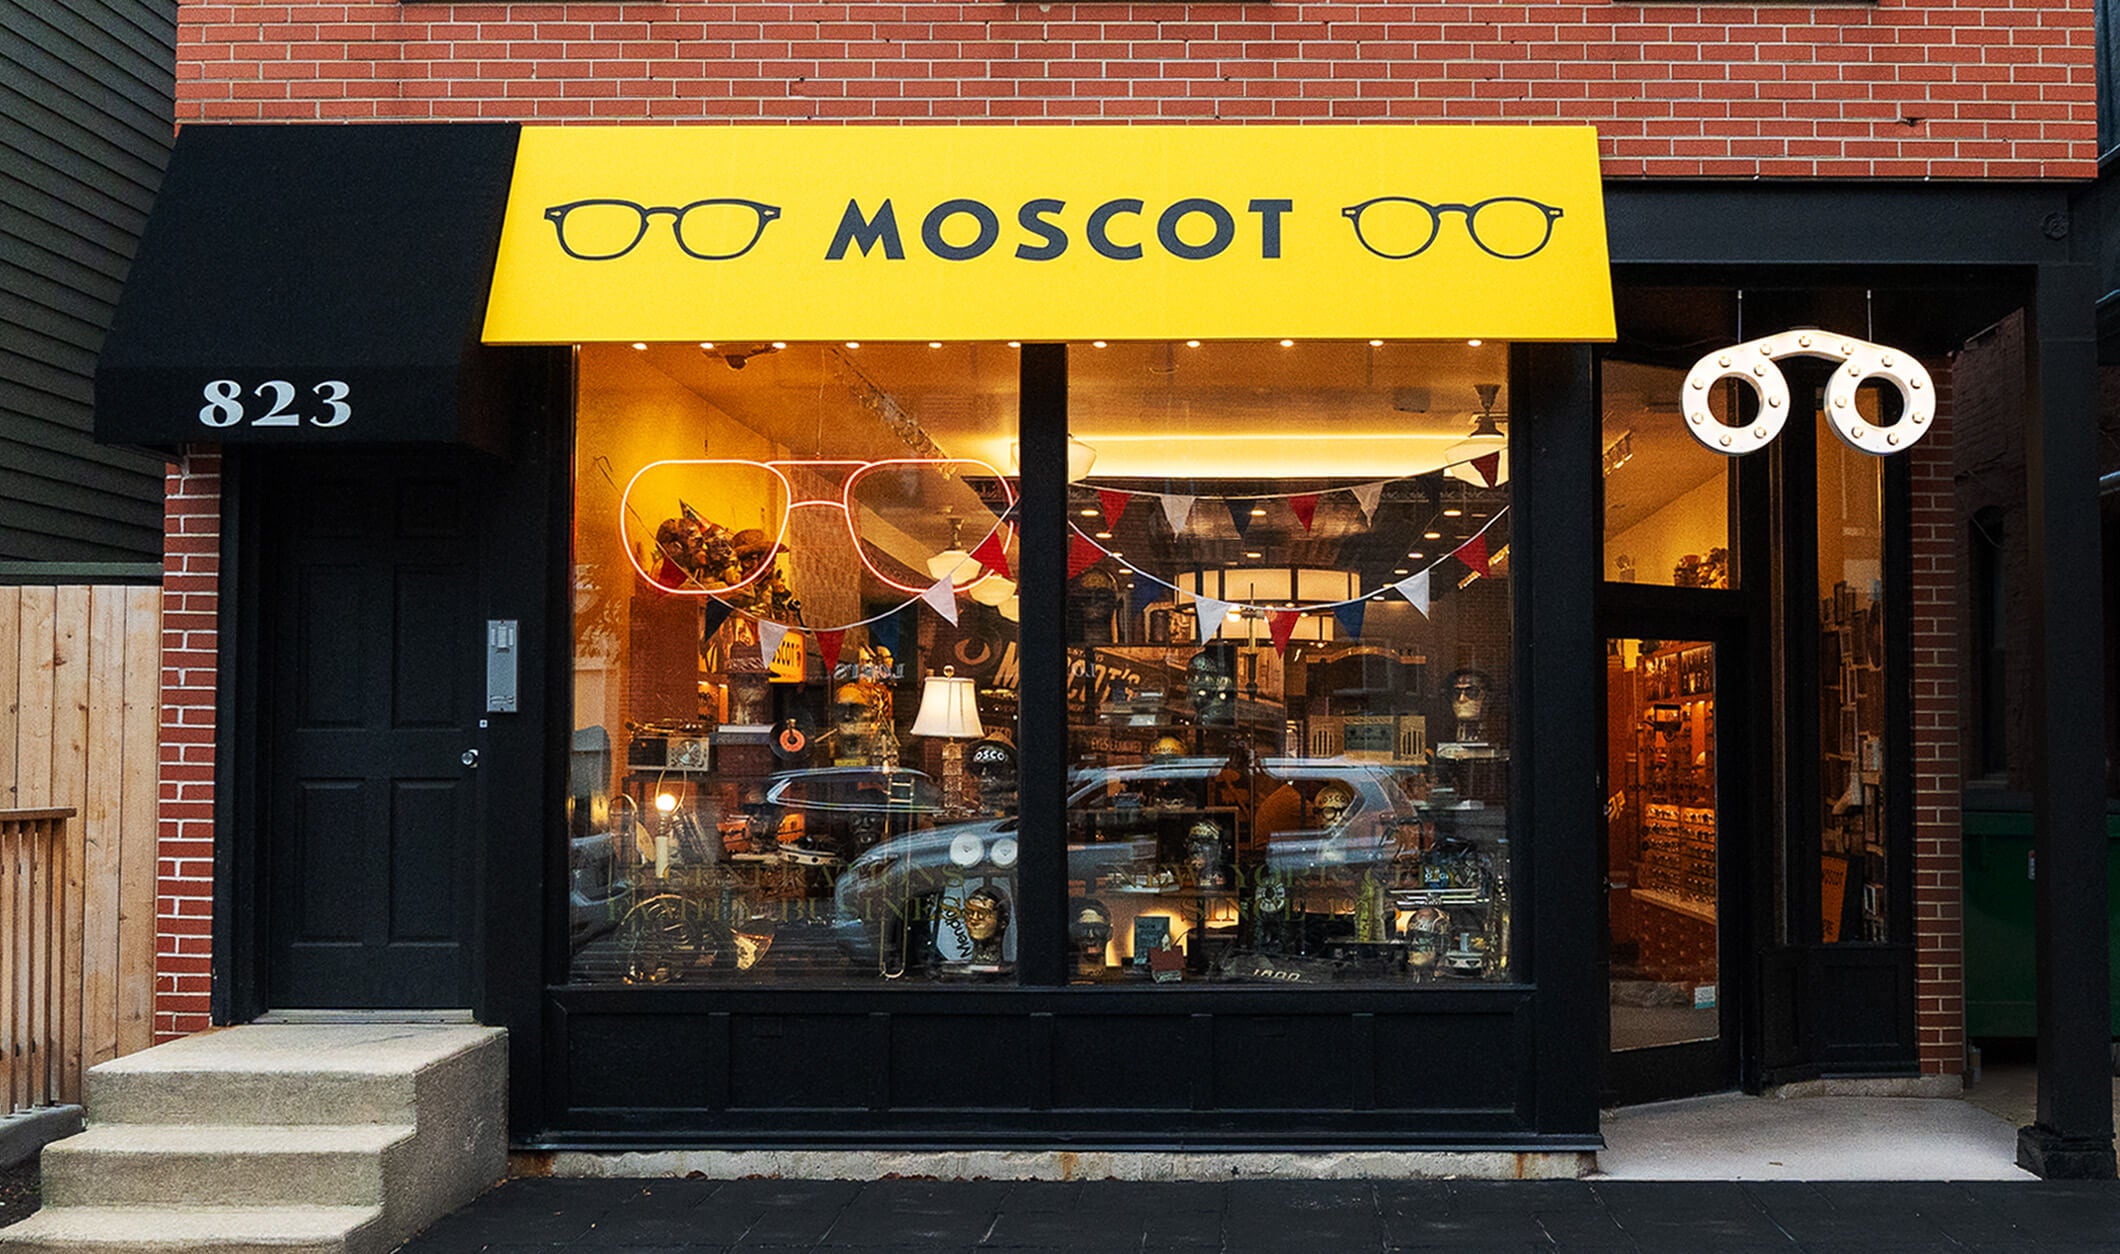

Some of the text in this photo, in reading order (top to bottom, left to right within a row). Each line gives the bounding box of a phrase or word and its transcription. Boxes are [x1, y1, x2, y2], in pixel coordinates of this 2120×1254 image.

[825, 199, 1292, 260] MOSCOT
[200, 380, 351, 427] 823
[779, 897, 978, 922] BUSINES
